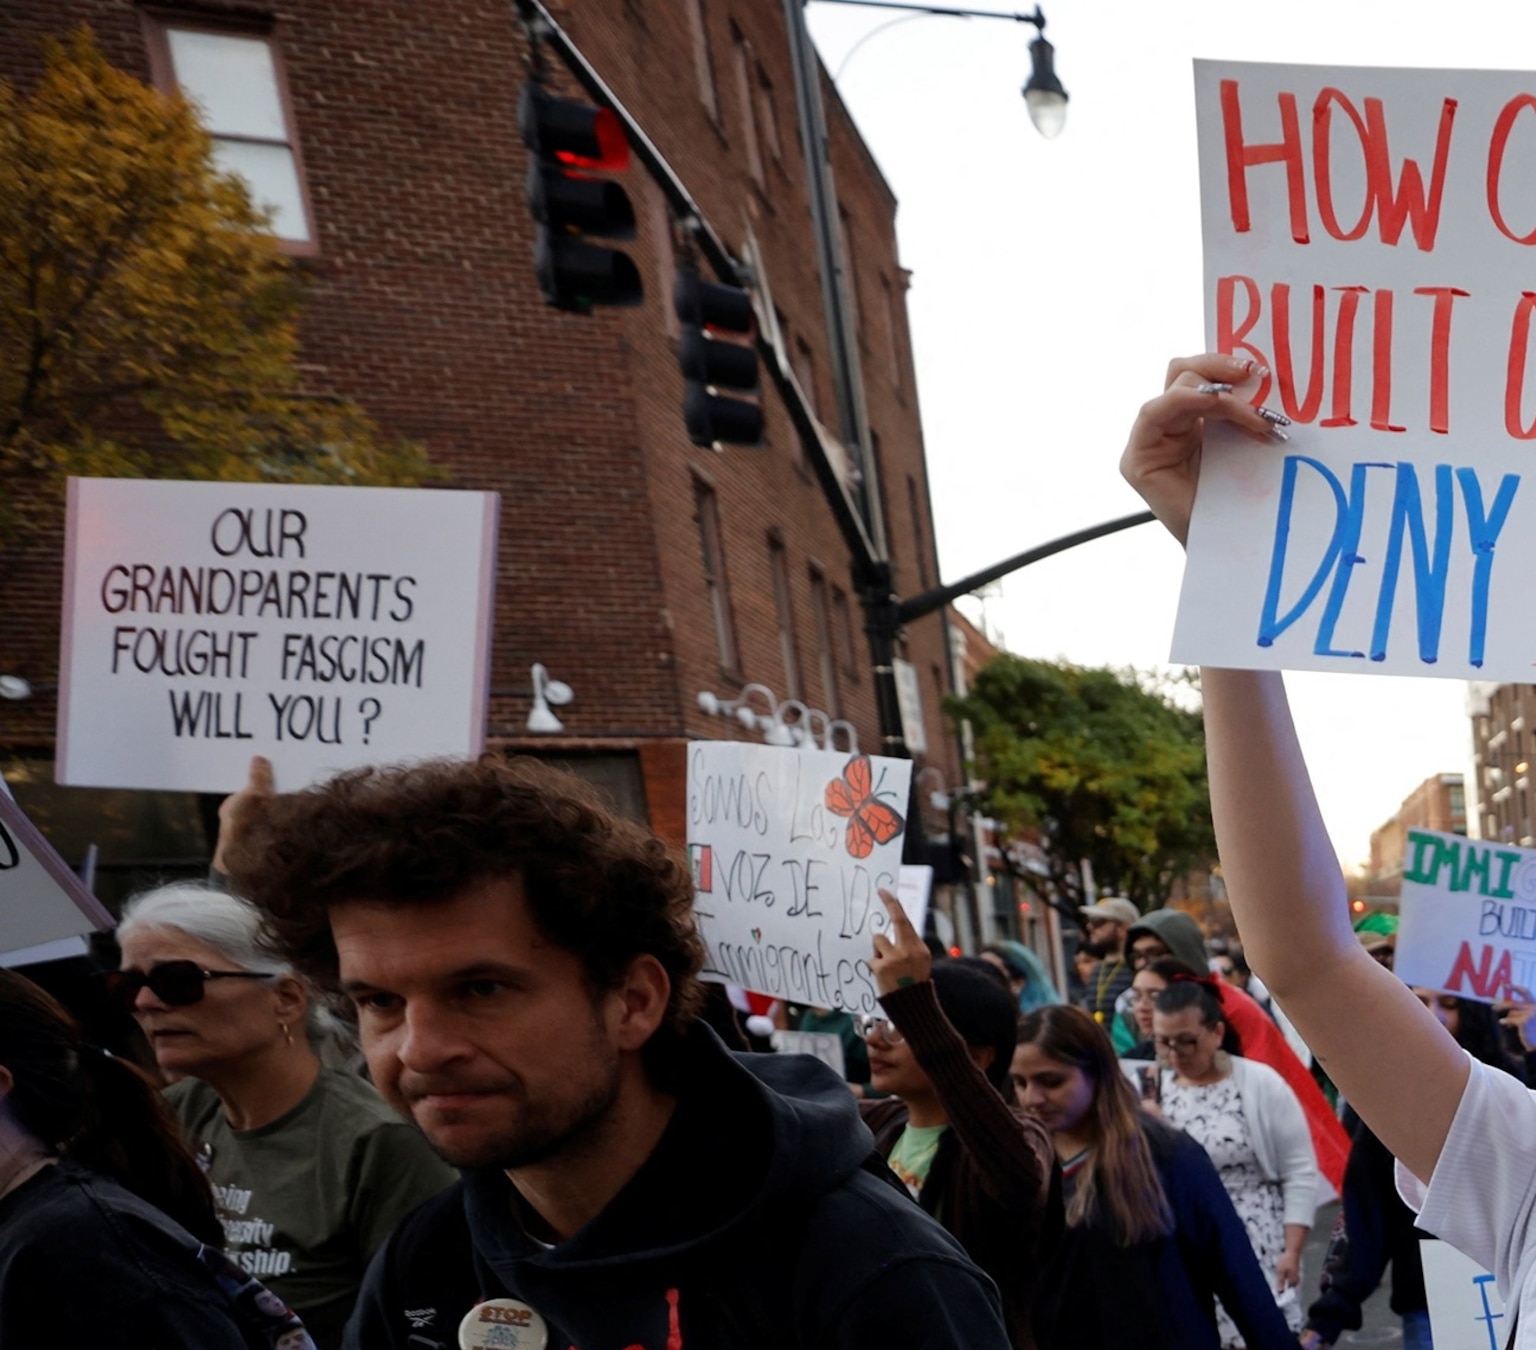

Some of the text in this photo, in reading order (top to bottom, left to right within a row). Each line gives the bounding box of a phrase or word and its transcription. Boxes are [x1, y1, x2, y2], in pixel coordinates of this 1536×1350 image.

[1220, 79, 1458, 252] HOW
[1217, 275, 1471, 434] BUILT
[212, 508, 307, 557] OUR
[1257, 455, 1521, 668] DENY
[101, 564, 417, 622] GRANDPARENTS
[112, 627, 424, 687] FOUGHT FASCISM
[169, 690, 252, 738] WILL
[713, 850, 776, 908] VOZ
[782, 858, 828, 917] DE
[480, 1306, 532, 1321] STOP
